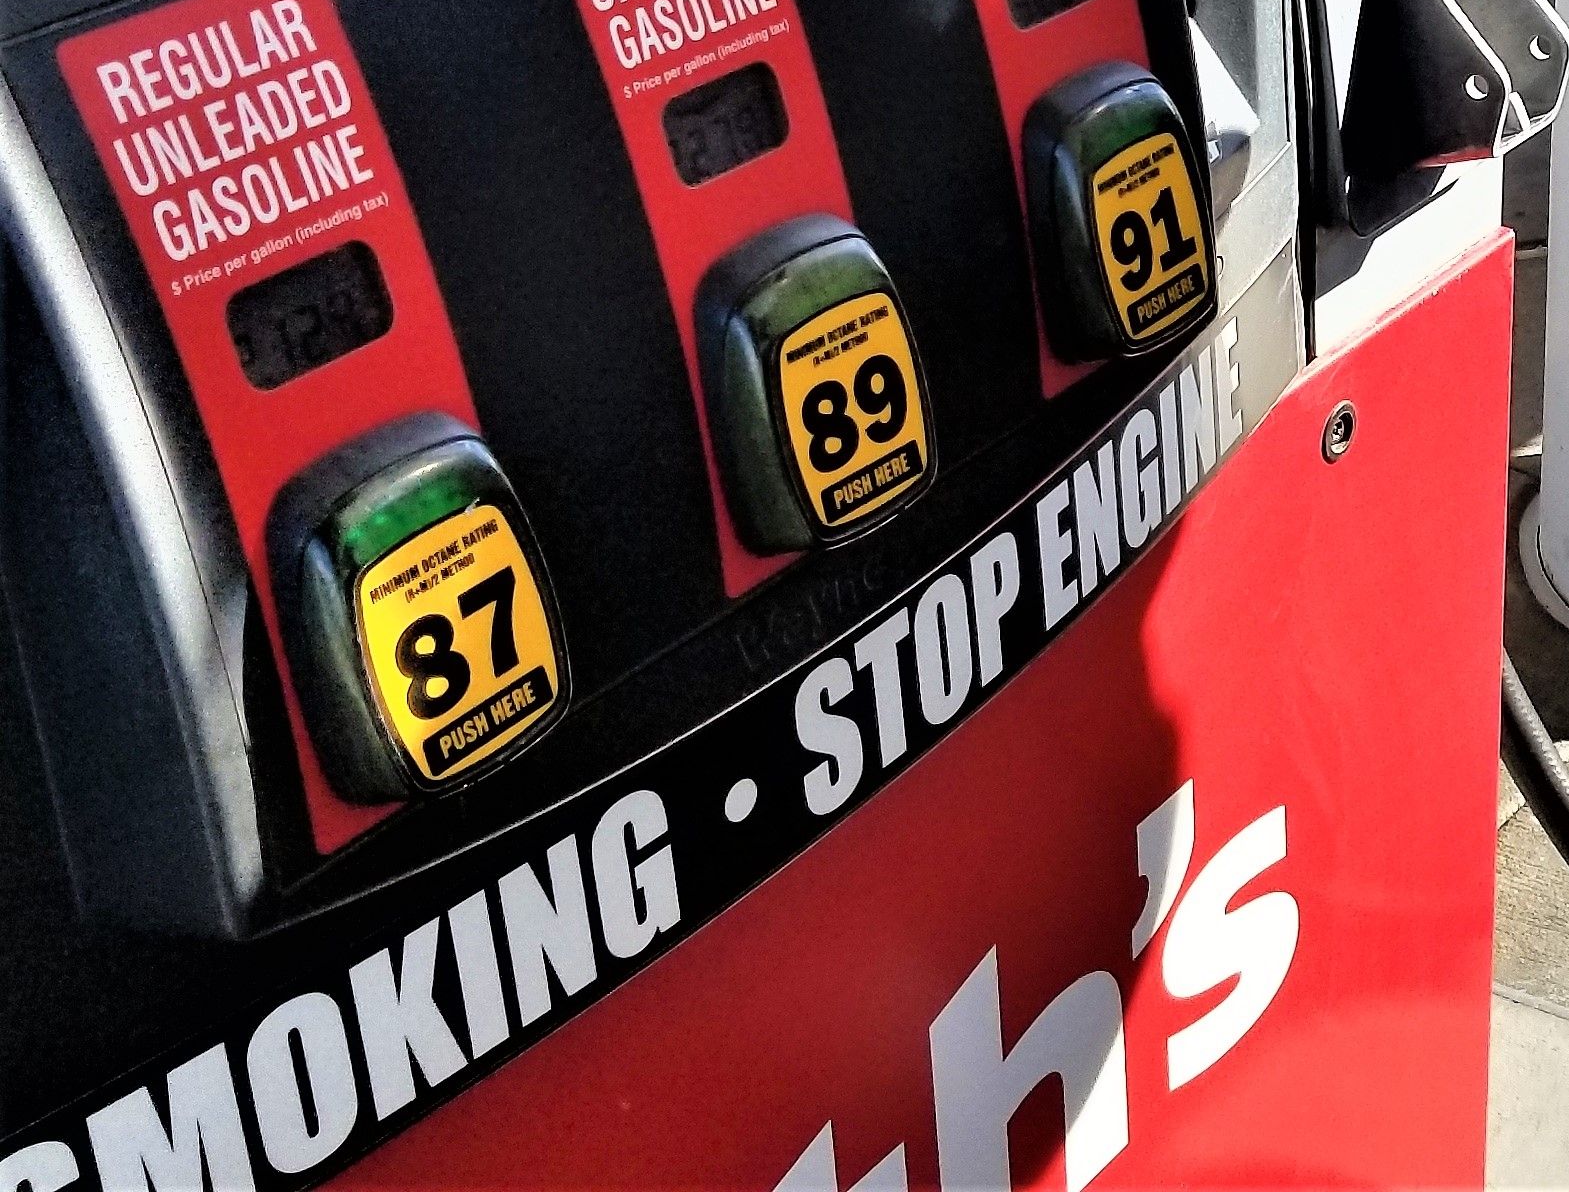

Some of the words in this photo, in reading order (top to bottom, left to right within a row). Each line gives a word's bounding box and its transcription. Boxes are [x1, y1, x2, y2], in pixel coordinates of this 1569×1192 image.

[633, 73, 662, 96] Price
[664, 66, 682, 85] per
[684, 49, 716, 76] gallon
[718, 27, 770, 61] (including
[769, 19, 790, 39] tax)
[113, 59, 353, 197] UNLEADED
[152, 124, 373, 262] GASOLINE
[183, 264, 221, 293] Price
[224, 253, 248, 278] per
[251, 234, 294, 264] gallon
[296, 206, 363, 245] (including
[363, 192, 390, 218] tax)
[1110, 186, 1197, 291] 91
[1137, 295, 1166, 325] PUSH
[1167, 274, 1195, 304] HERE
[801, 354, 908, 473] 89
[833, 472, 872, 510] PUSH
[873, 452, 911, 488] HERE
[370, 564, 420, 604] MINIMUM
[422, 540, 462, 577] OCTANE
[461, 519, 499, 550] RATING
[794, 532, 1021, 818] STOP
[1037, 316, 1244, 628] ENGINE
[395, 566, 521, 720] 87
[439, 708, 491, 759] PUSH
[491, 681, 537, 727] HERE
